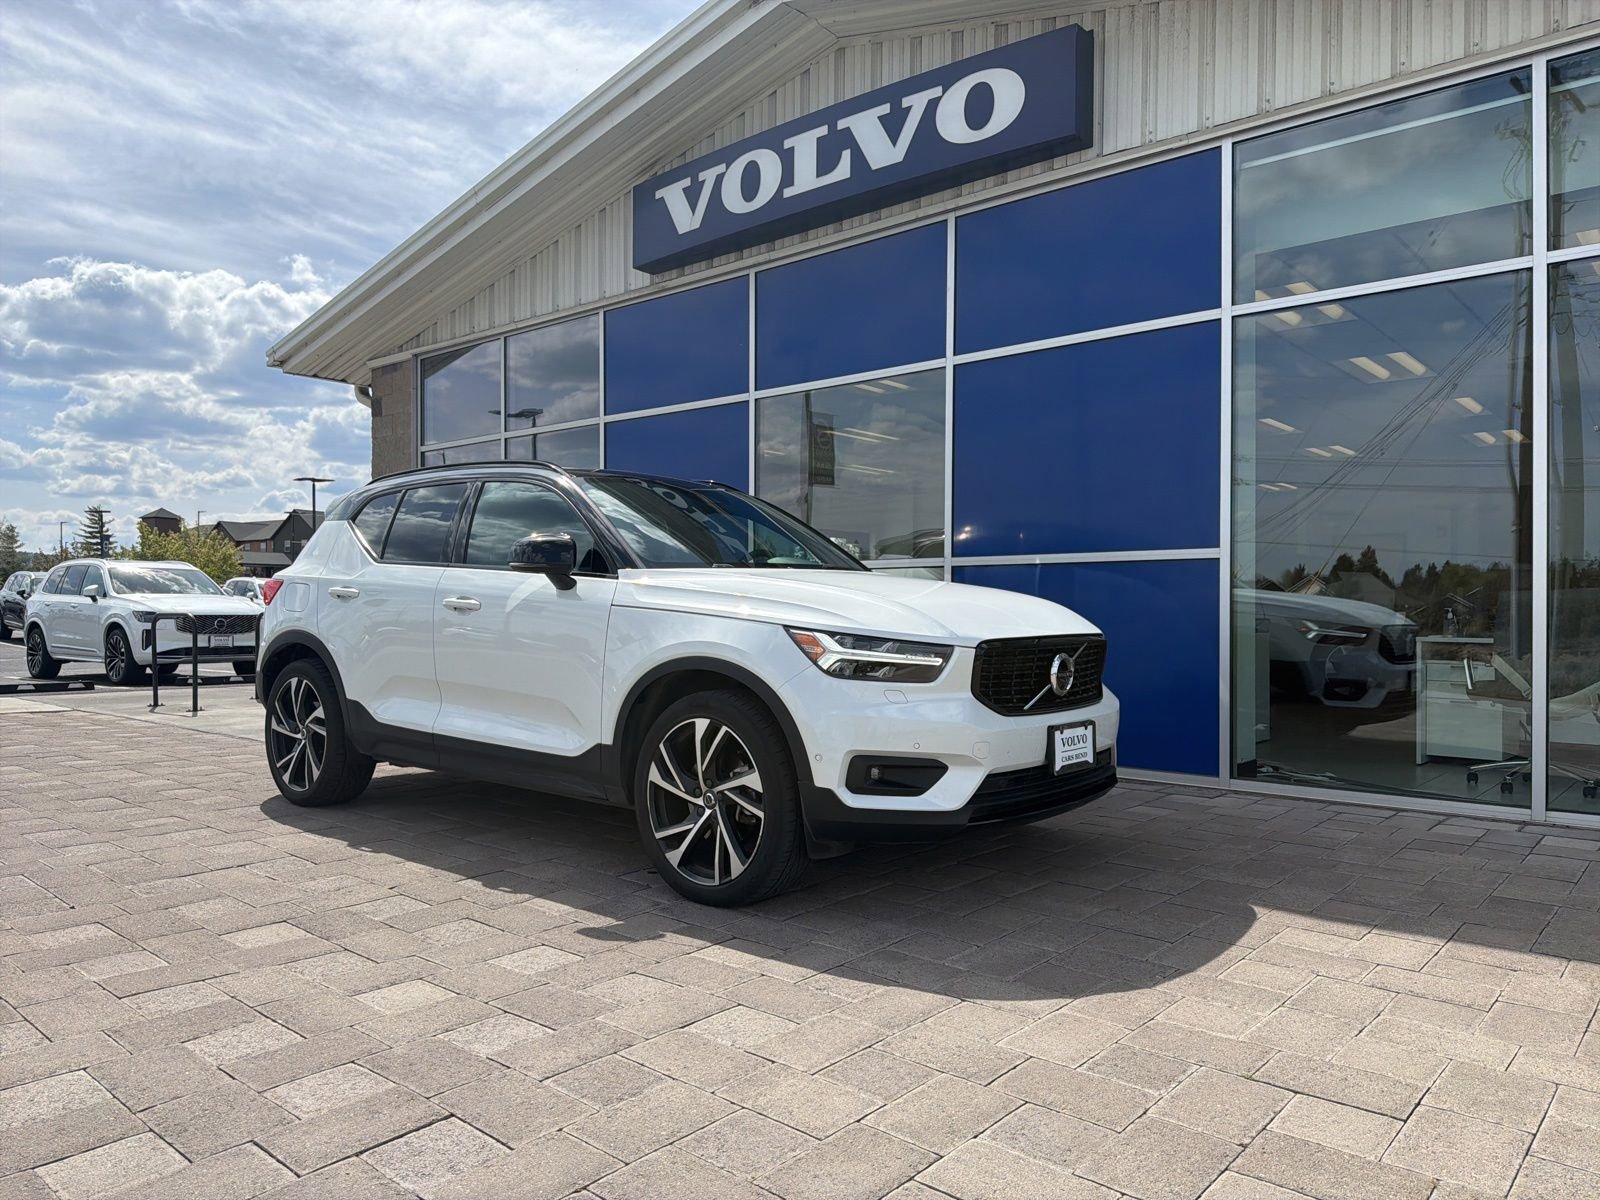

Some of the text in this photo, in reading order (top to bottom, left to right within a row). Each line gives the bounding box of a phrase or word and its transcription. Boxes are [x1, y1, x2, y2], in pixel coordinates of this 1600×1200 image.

[655, 67, 1026, 235] VOLVO
[1061, 733, 1088, 748] VOLVO
[1061, 752, 1088, 763] CARS BEND
